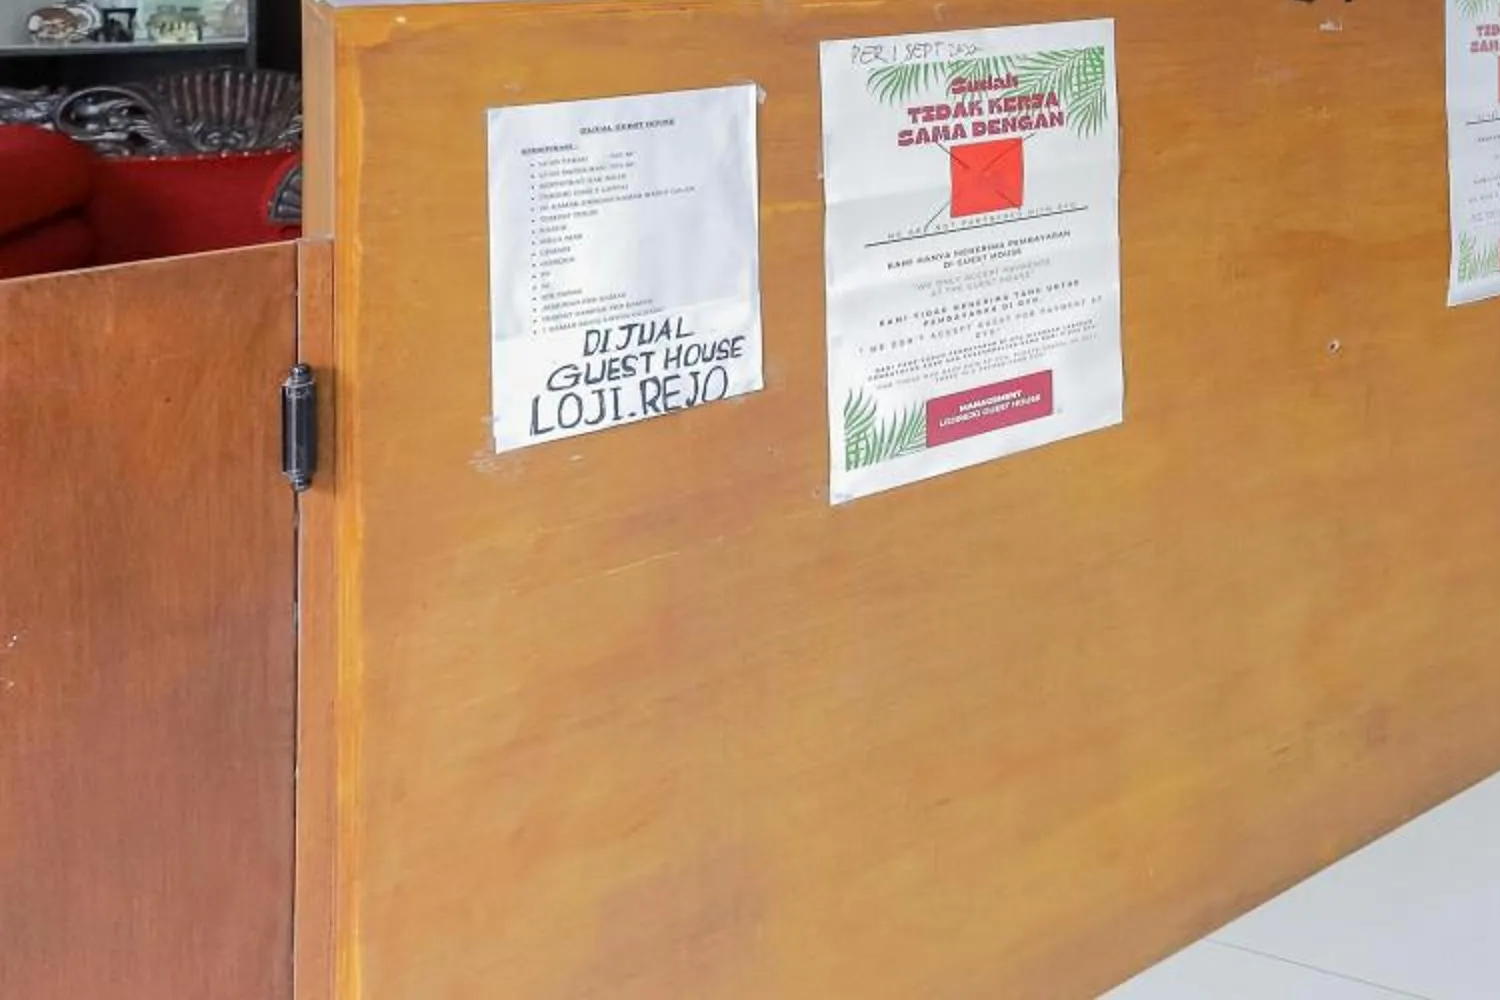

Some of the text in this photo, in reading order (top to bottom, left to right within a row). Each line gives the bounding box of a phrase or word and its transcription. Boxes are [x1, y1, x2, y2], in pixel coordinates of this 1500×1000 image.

[951, 73, 1019, 95] Sudah
[907, 91, 1061, 124] TIDAK KERJA
[897, 110, 1065, 147] SAMA DENGAN
[546, 335, 746, 393] GUEST HOUSE
